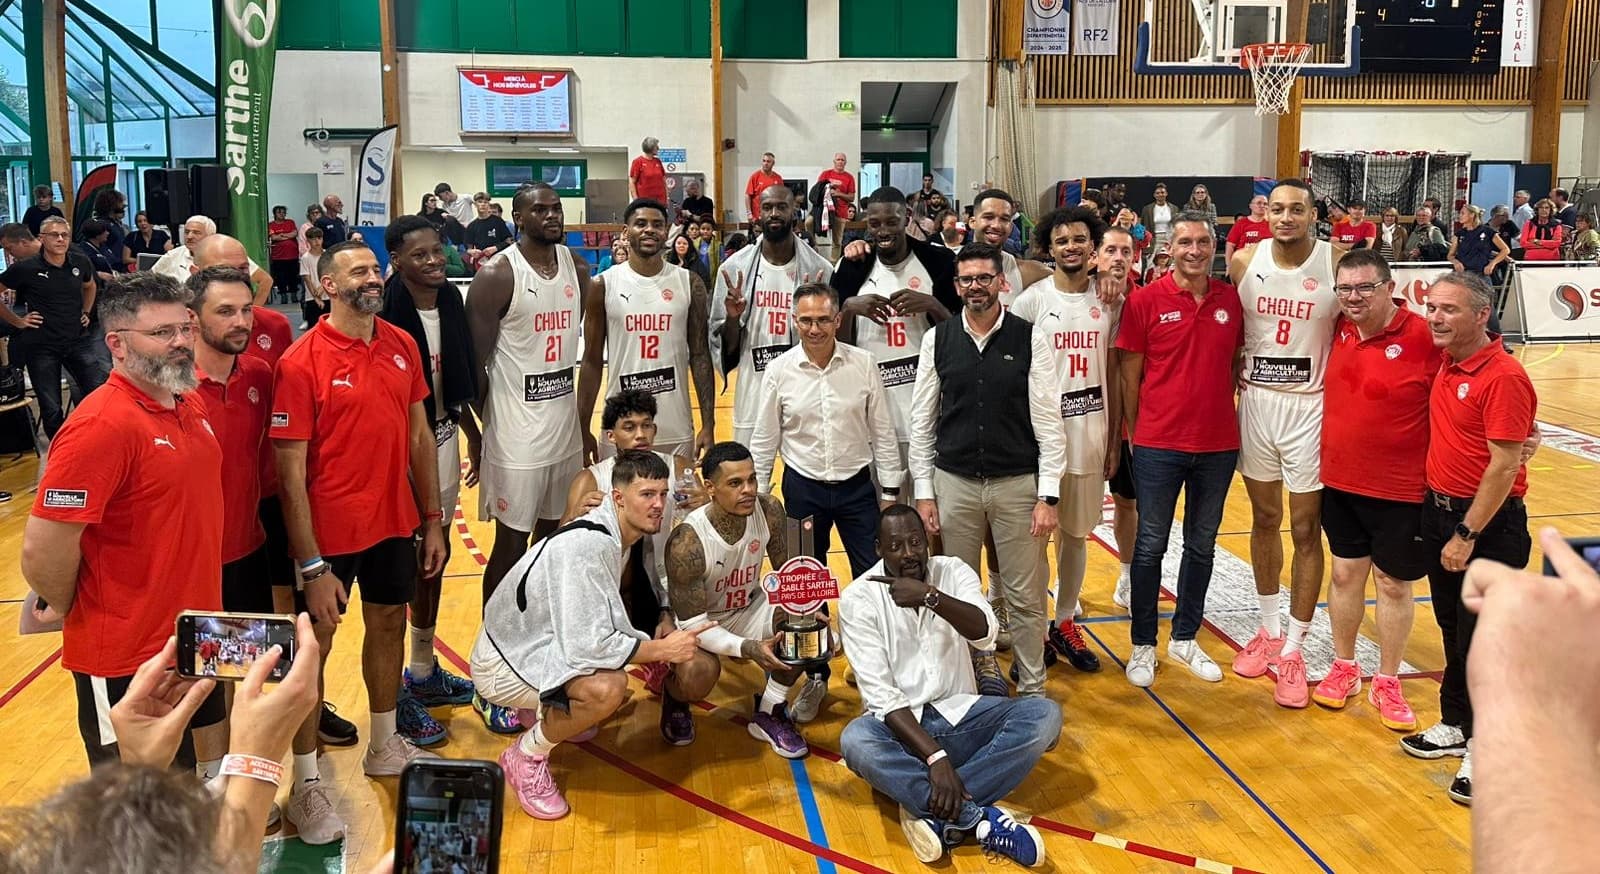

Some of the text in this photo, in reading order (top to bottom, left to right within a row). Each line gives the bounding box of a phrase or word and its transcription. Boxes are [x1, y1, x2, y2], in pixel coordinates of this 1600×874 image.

[1377, 8, 1386, 21] 4
[1084, 29, 1108, 41] RF2
[224, 60, 250, 196] Sarthe
[756, 290, 792, 310] CHOLE
[1257, 296, 1316, 320] CHOLET
[534, 310, 572, 332] CHOLET
[626, 314, 672, 332] CHOLET
[768, 312, 787, 336] 15
[884, 322, 906, 347] 16
[1054, 331, 1100, 350] CHOLET
[1276, 320, 1291, 345] 8
[544, 335, 562, 362] 21
[639, 335, 660, 360] 12
[881, 369, 917, 380] GRICULTU
[1068, 354, 1088, 378] 14
[630, 375, 664, 386] NOUVELLE
[715, 563, 759, 592] CHOLET
[780, 572, 816, 582] TROPHÉE
[780, 580, 836, 592] SABLÉ SARTHE
[726, 589, 746, 608] 13
[817, 589, 836, 597] LOIRE
